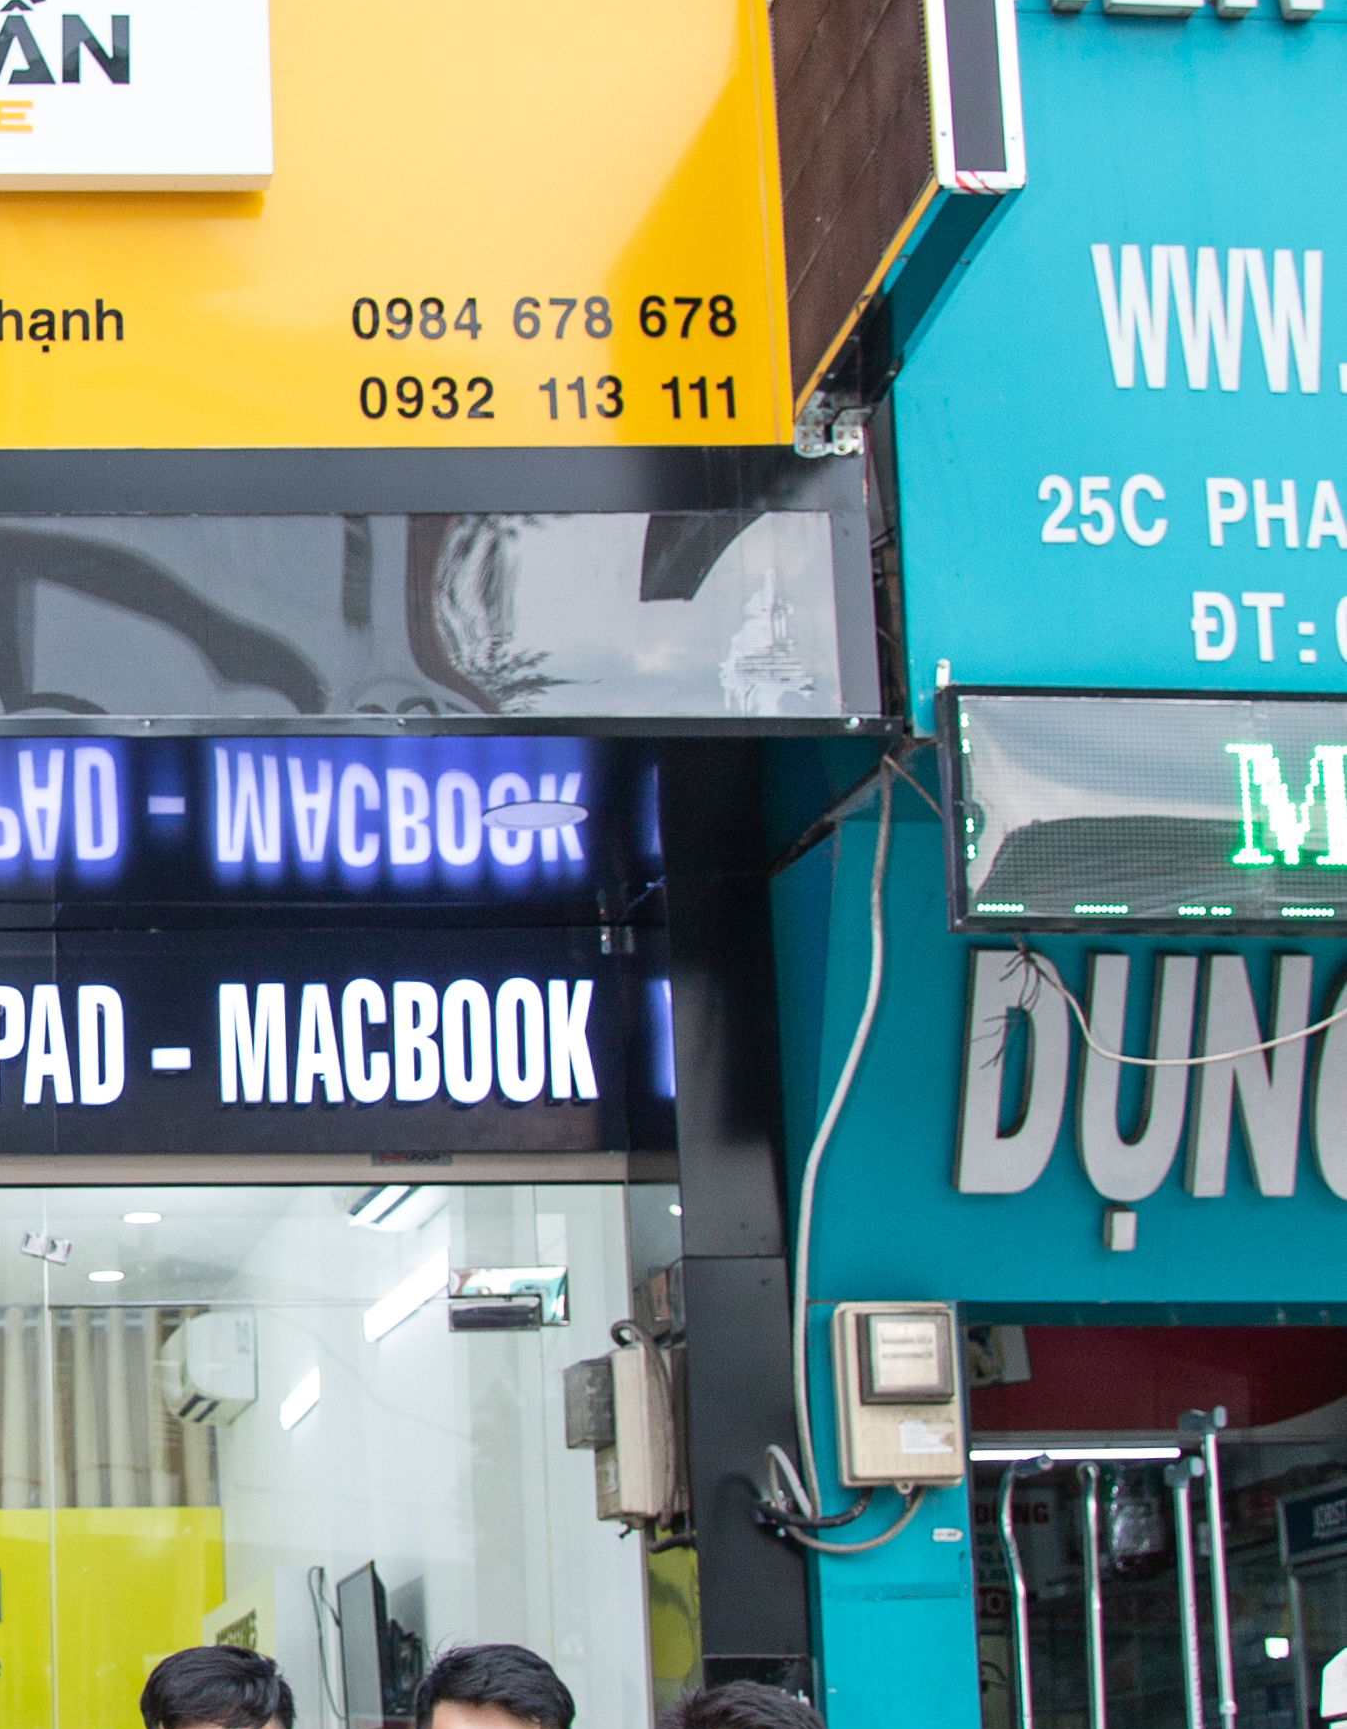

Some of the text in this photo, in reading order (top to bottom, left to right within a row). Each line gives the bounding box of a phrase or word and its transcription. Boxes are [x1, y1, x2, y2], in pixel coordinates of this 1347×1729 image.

[352, 295, 736, 340] 0984 678 678
[360, 375, 735, 419] 0932 113 111
[1038, 474, 1168, 546] 25C
[219, 978, 599, 1105] MACBOOK
